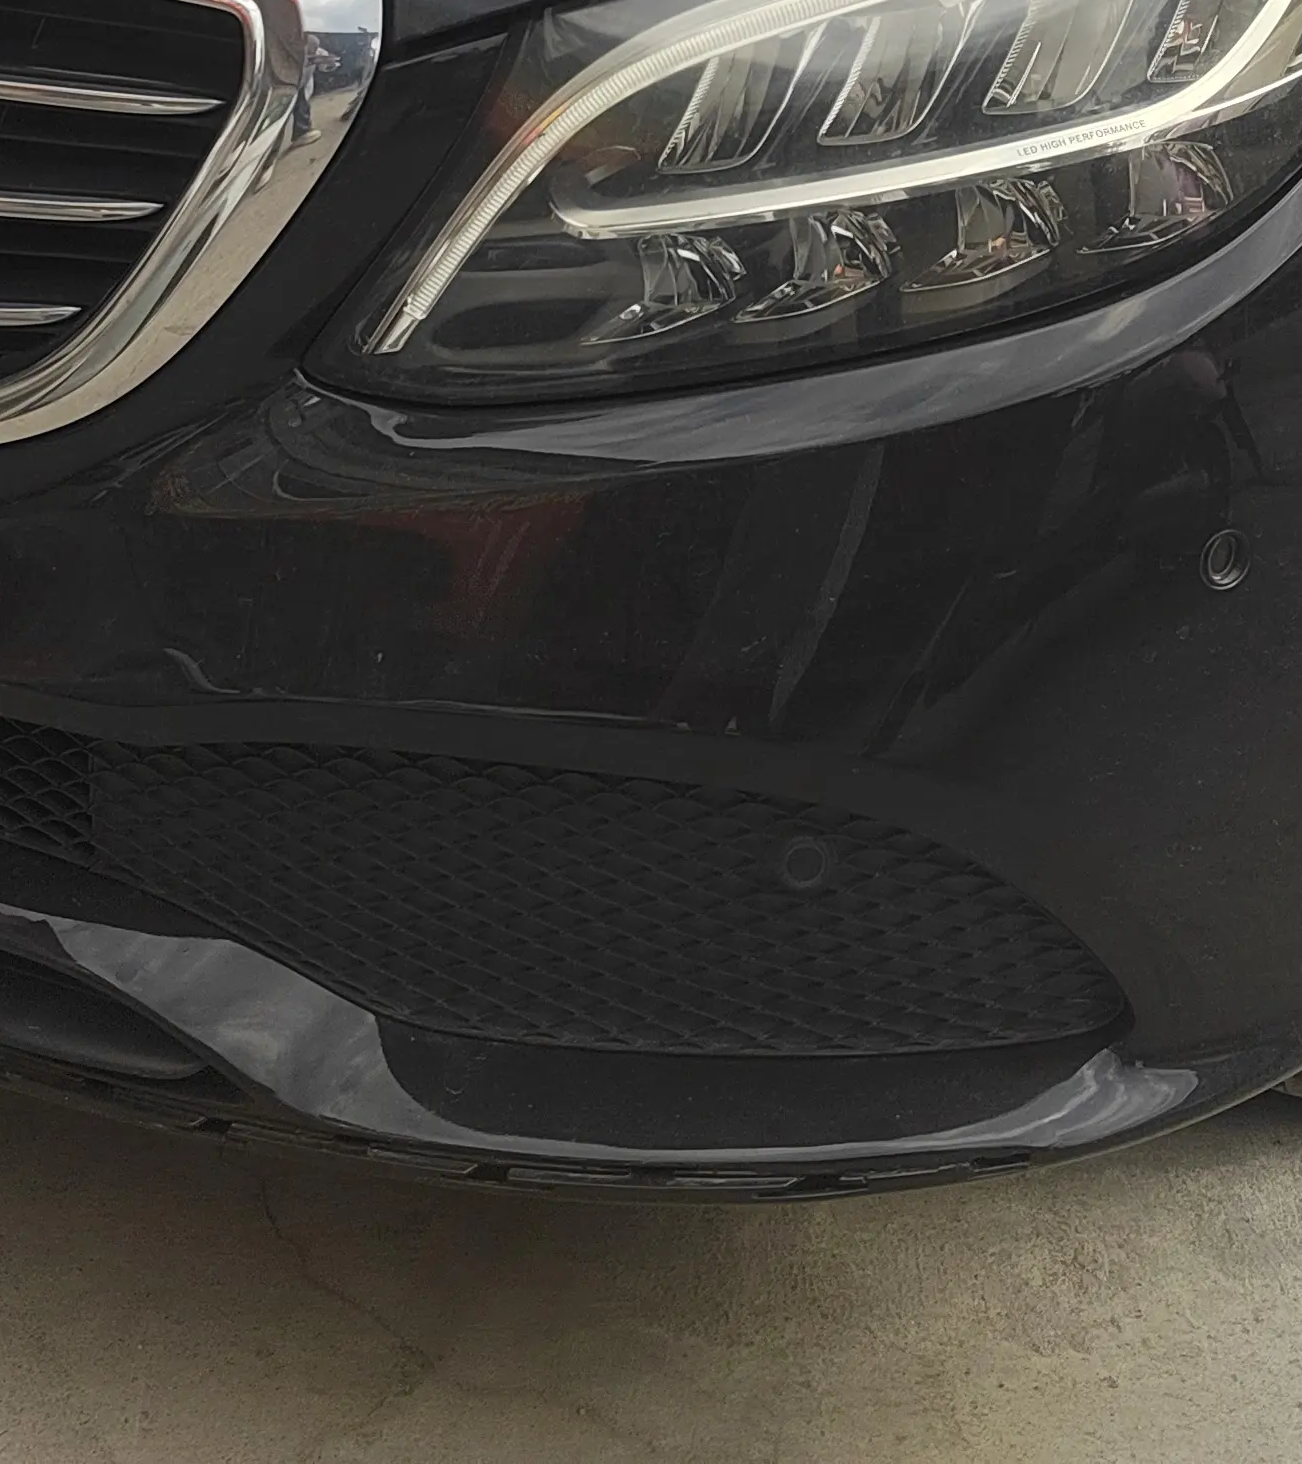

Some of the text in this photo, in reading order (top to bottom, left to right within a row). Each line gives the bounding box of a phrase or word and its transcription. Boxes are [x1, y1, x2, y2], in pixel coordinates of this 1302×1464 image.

[1017, 119, 1147, 157] LED HIGH PERFORMANCE
